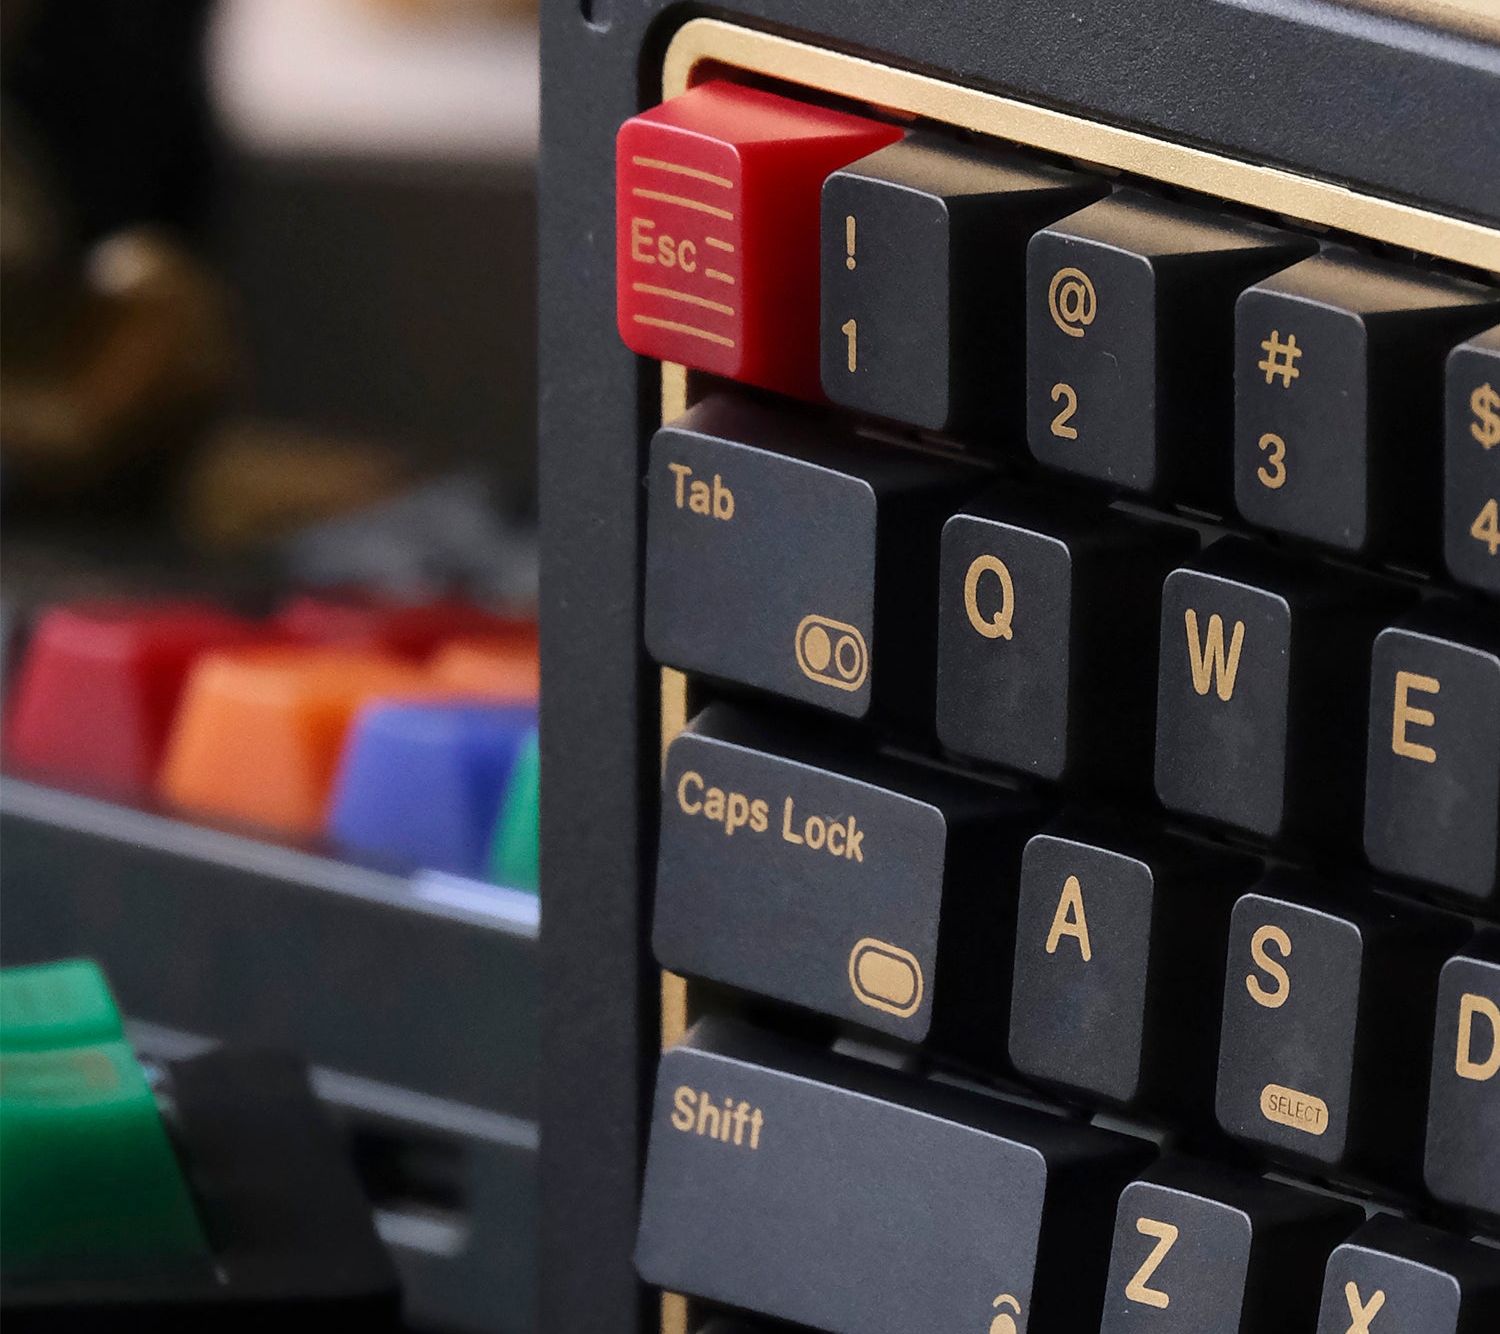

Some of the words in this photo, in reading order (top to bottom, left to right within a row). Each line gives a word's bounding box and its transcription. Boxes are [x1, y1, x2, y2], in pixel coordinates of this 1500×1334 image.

[630, 222, 698, 275] Esc
[846, 215, 857, 270] !
[1048, 266, 1097, 338] @
[841, 319, 857, 373] 1
[1258, 330, 1303, 388] #
[1050, 382, 1078, 440] 2
[669, 462, 735, 521] Tab
[1257, 432, 1287, 489] 3
[964, 554, 1015, 640] Q
[1185, 608, 1245, 701] W
[1391, 670, 1441, 763] E
[677, 770, 769, 836] Caps
[782, 796, 865, 863] Lock
[1045, 874, 1092, 962] A
[1245, 924, 1292, 1008] S
[671, 1085, 764, 1149] Shift
[1268, 1093, 1322, 1124] SELECT
[1125, 1216, 1179, 1308] Z
